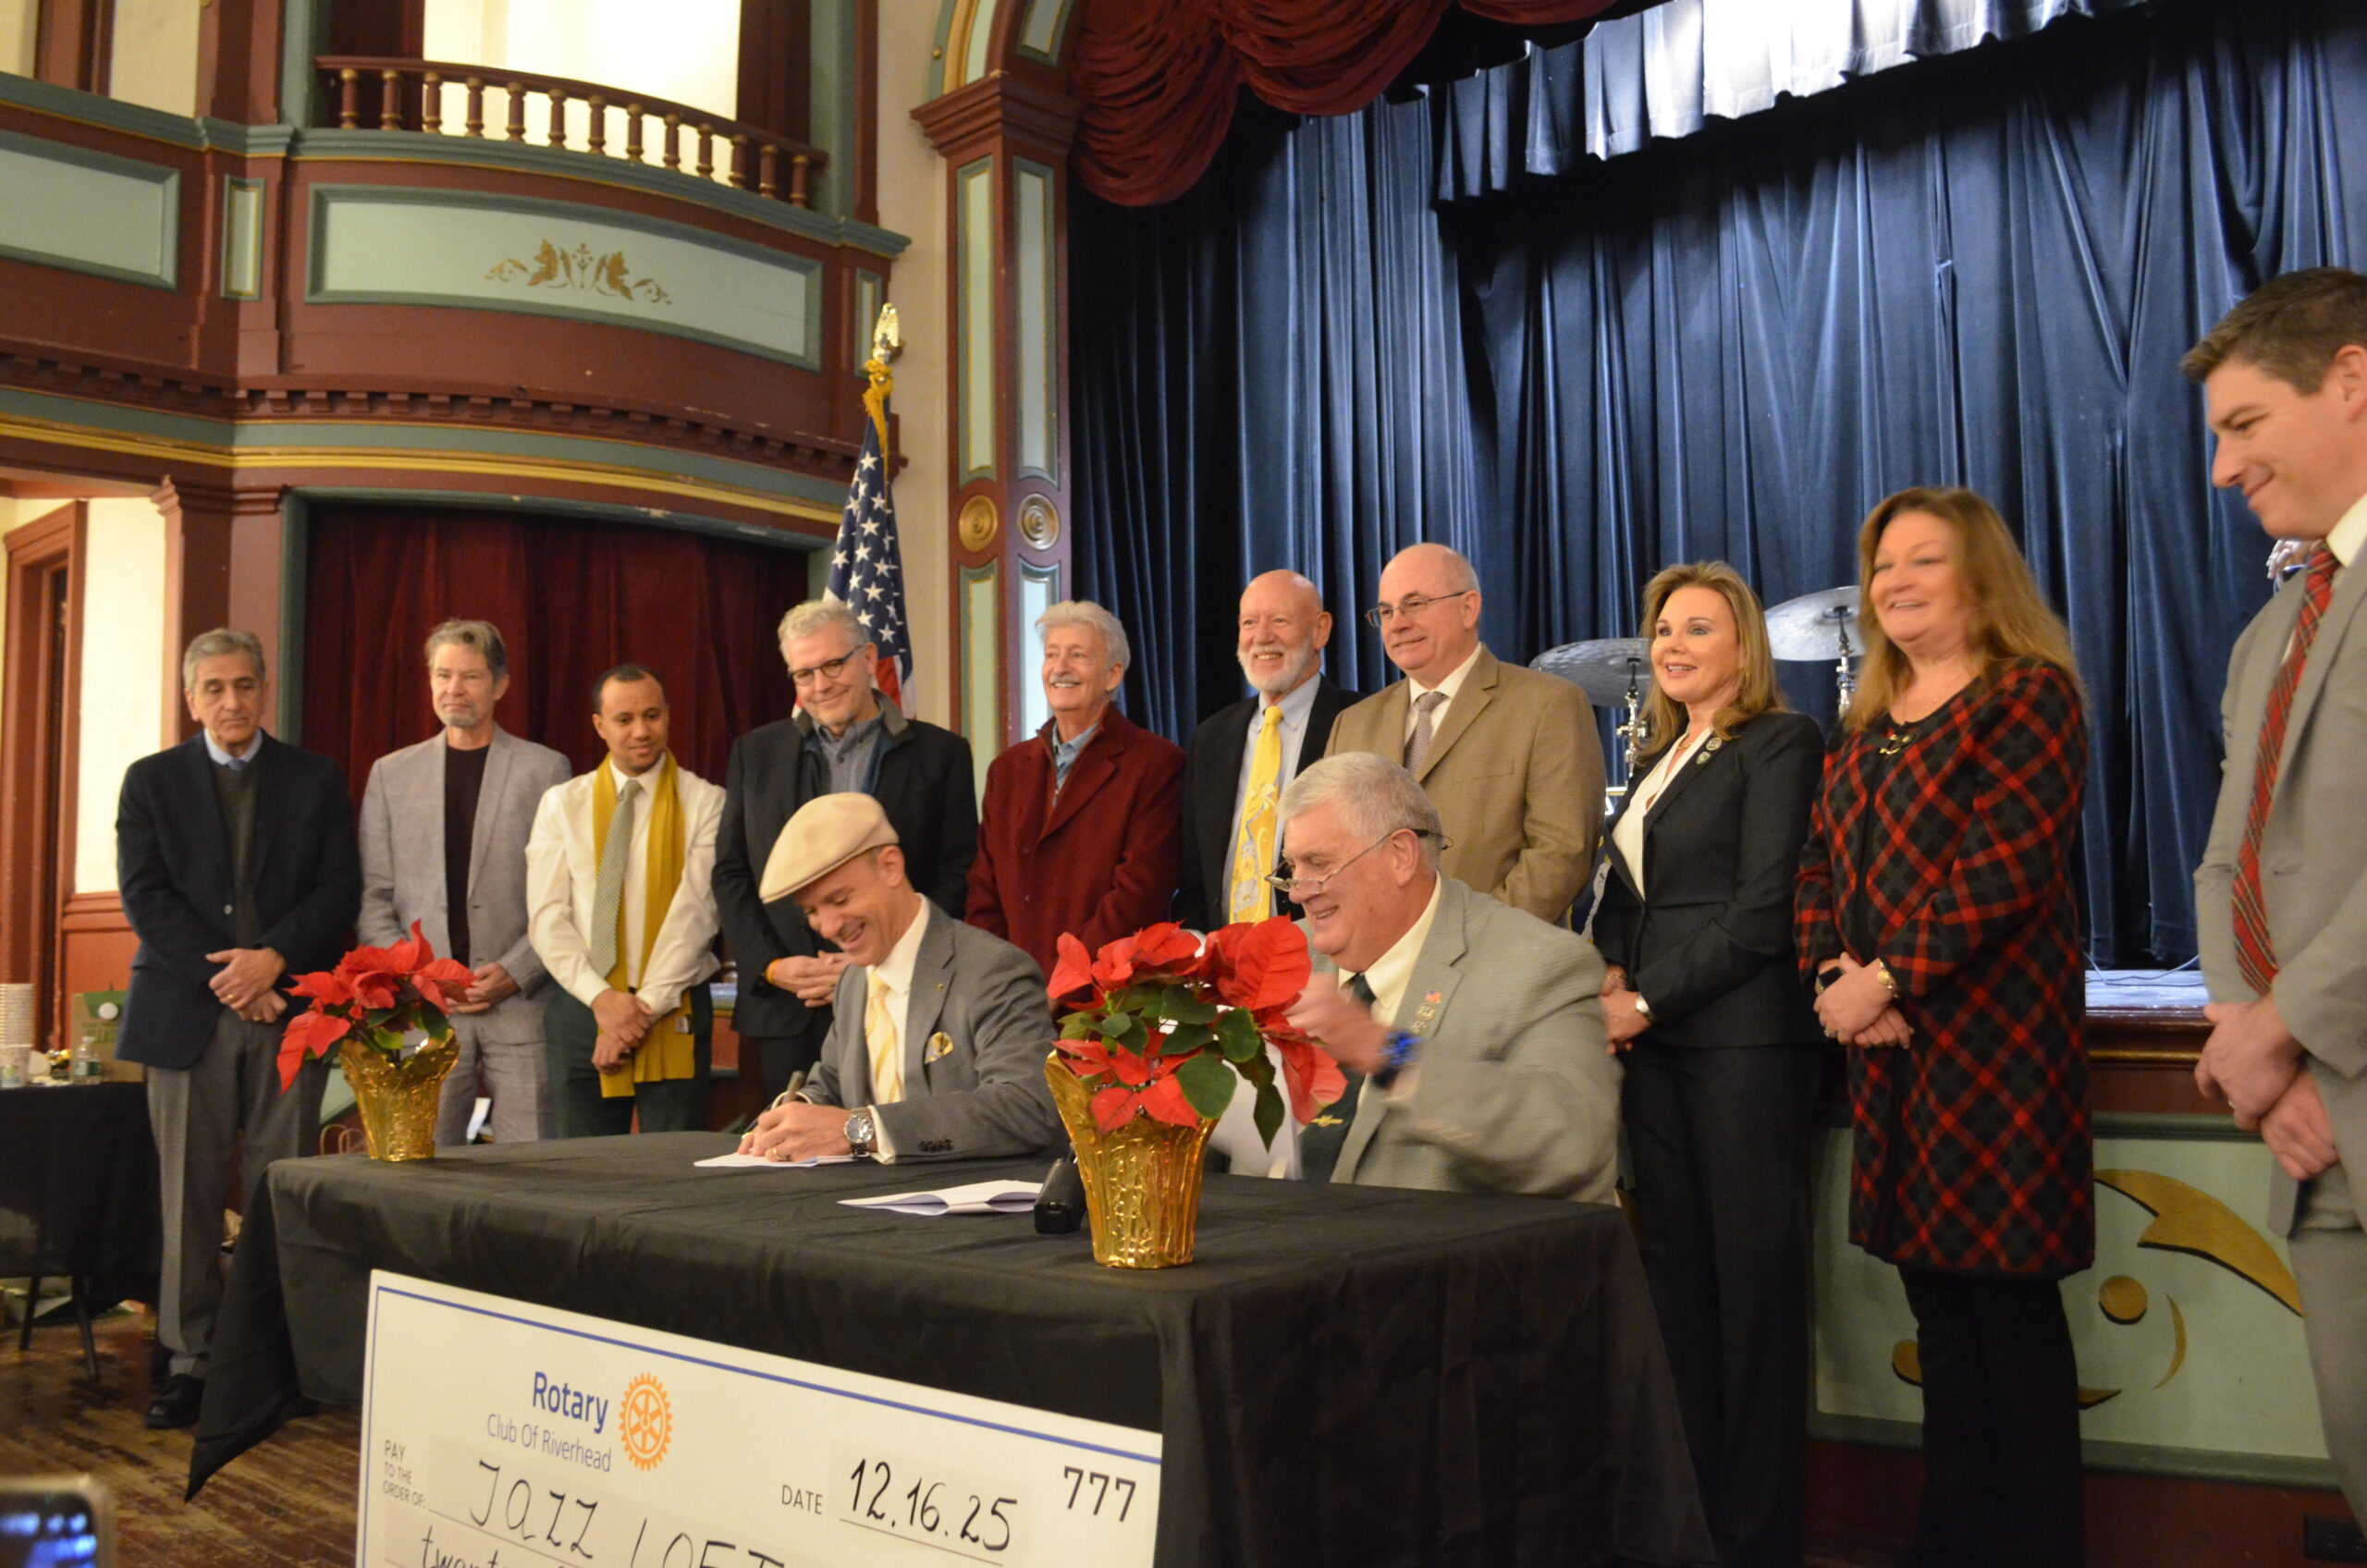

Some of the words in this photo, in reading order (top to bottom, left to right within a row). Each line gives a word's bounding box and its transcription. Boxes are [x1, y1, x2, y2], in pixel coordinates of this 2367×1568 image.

[533, 1371, 608, 1434] Rotary
[384, 1439, 406, 1463] PAY
[487, 1414, 518, 1443] Club
[521, 1424, 538, 1450] Of
[542, 1429, 612, 1472] Riverhead
[383, 1480, 411, 1503] ORDER
[384, 1462, 396, 1479] TO
[398, 1466, 412, 1485] THE
[1063, 1465, 1136, 1522] 777
[781, 1485, 823, 1514] DATE
[850, 1458, 1017, 1551] 12.16.25
